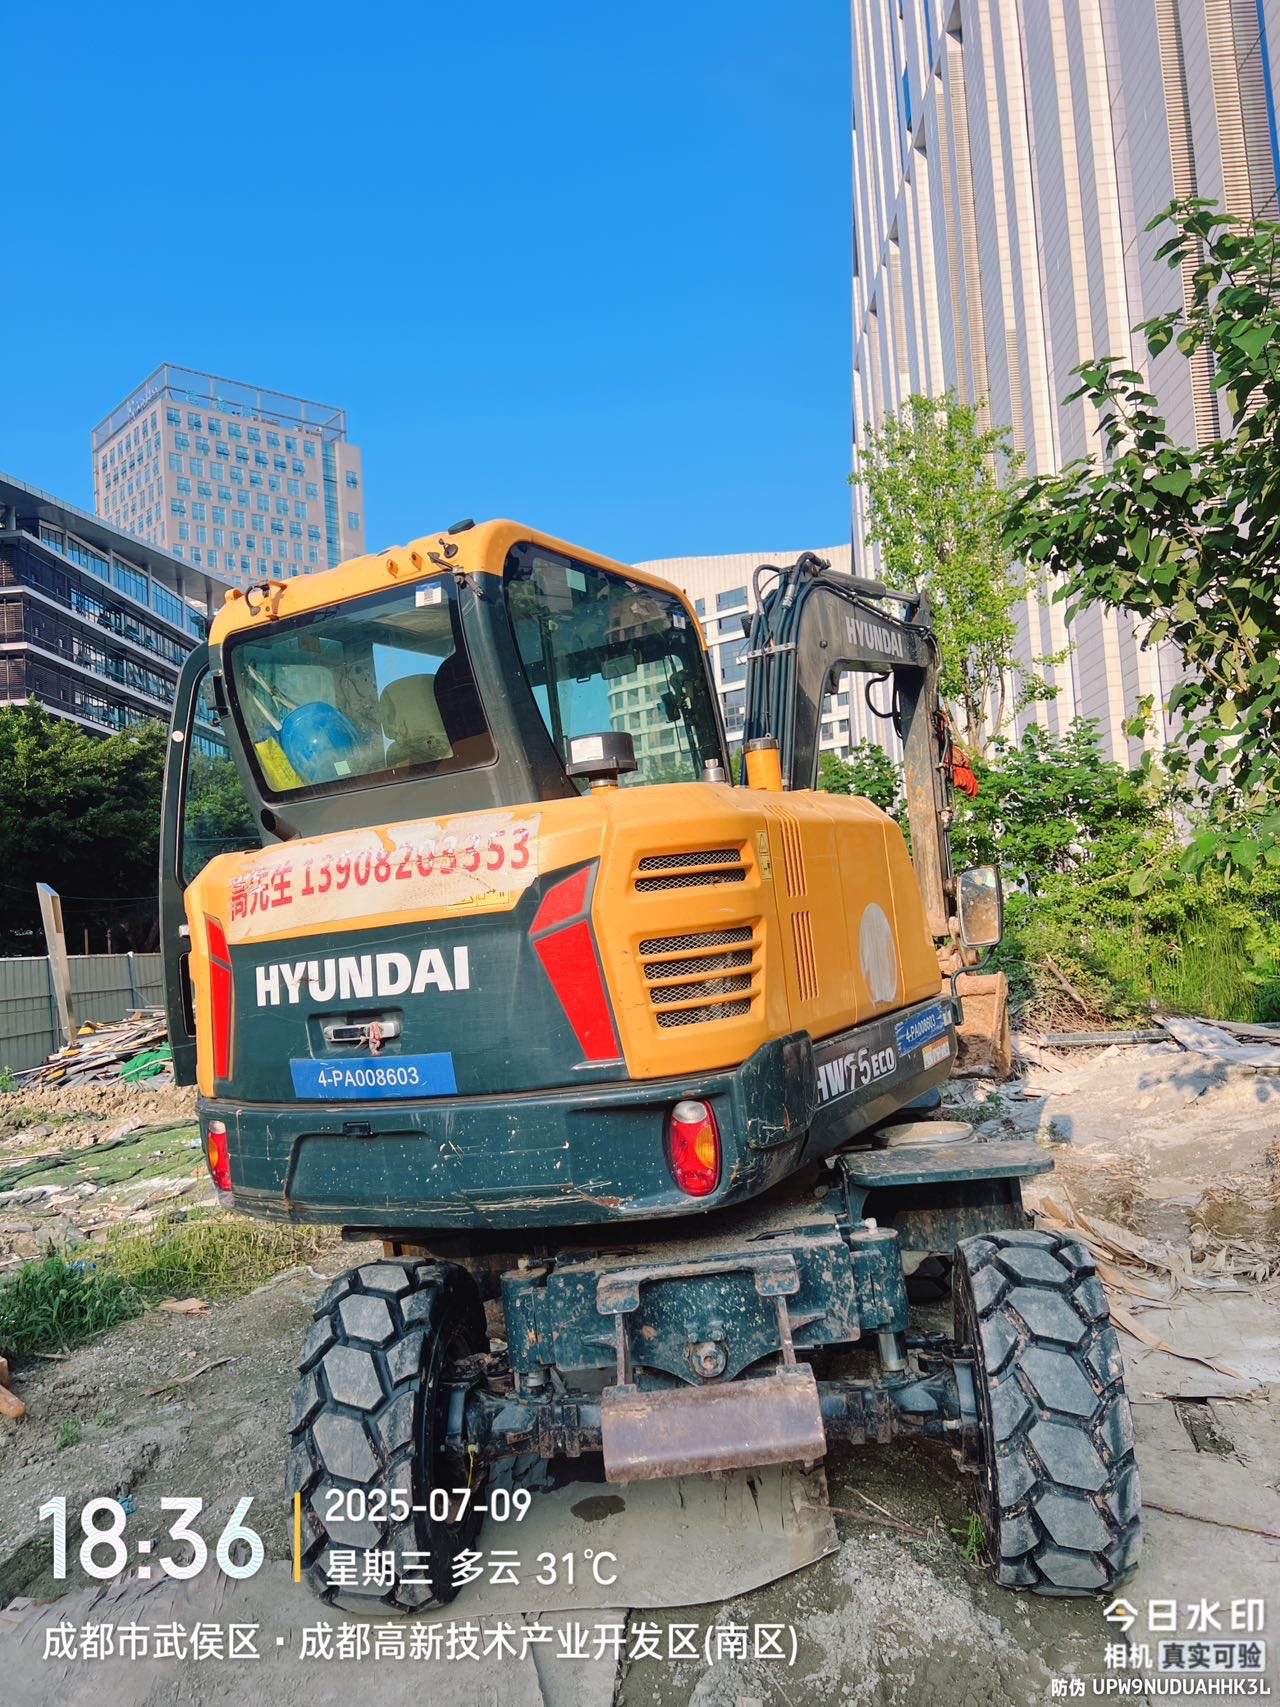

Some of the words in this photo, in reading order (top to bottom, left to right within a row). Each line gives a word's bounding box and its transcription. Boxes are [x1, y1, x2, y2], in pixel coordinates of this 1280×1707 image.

[845, 616, 904, 658] HYUNDAI
[255, 946, 470, 1007] HYUNDAI
[318, 1067, 420, 1088] 4-PA008603
